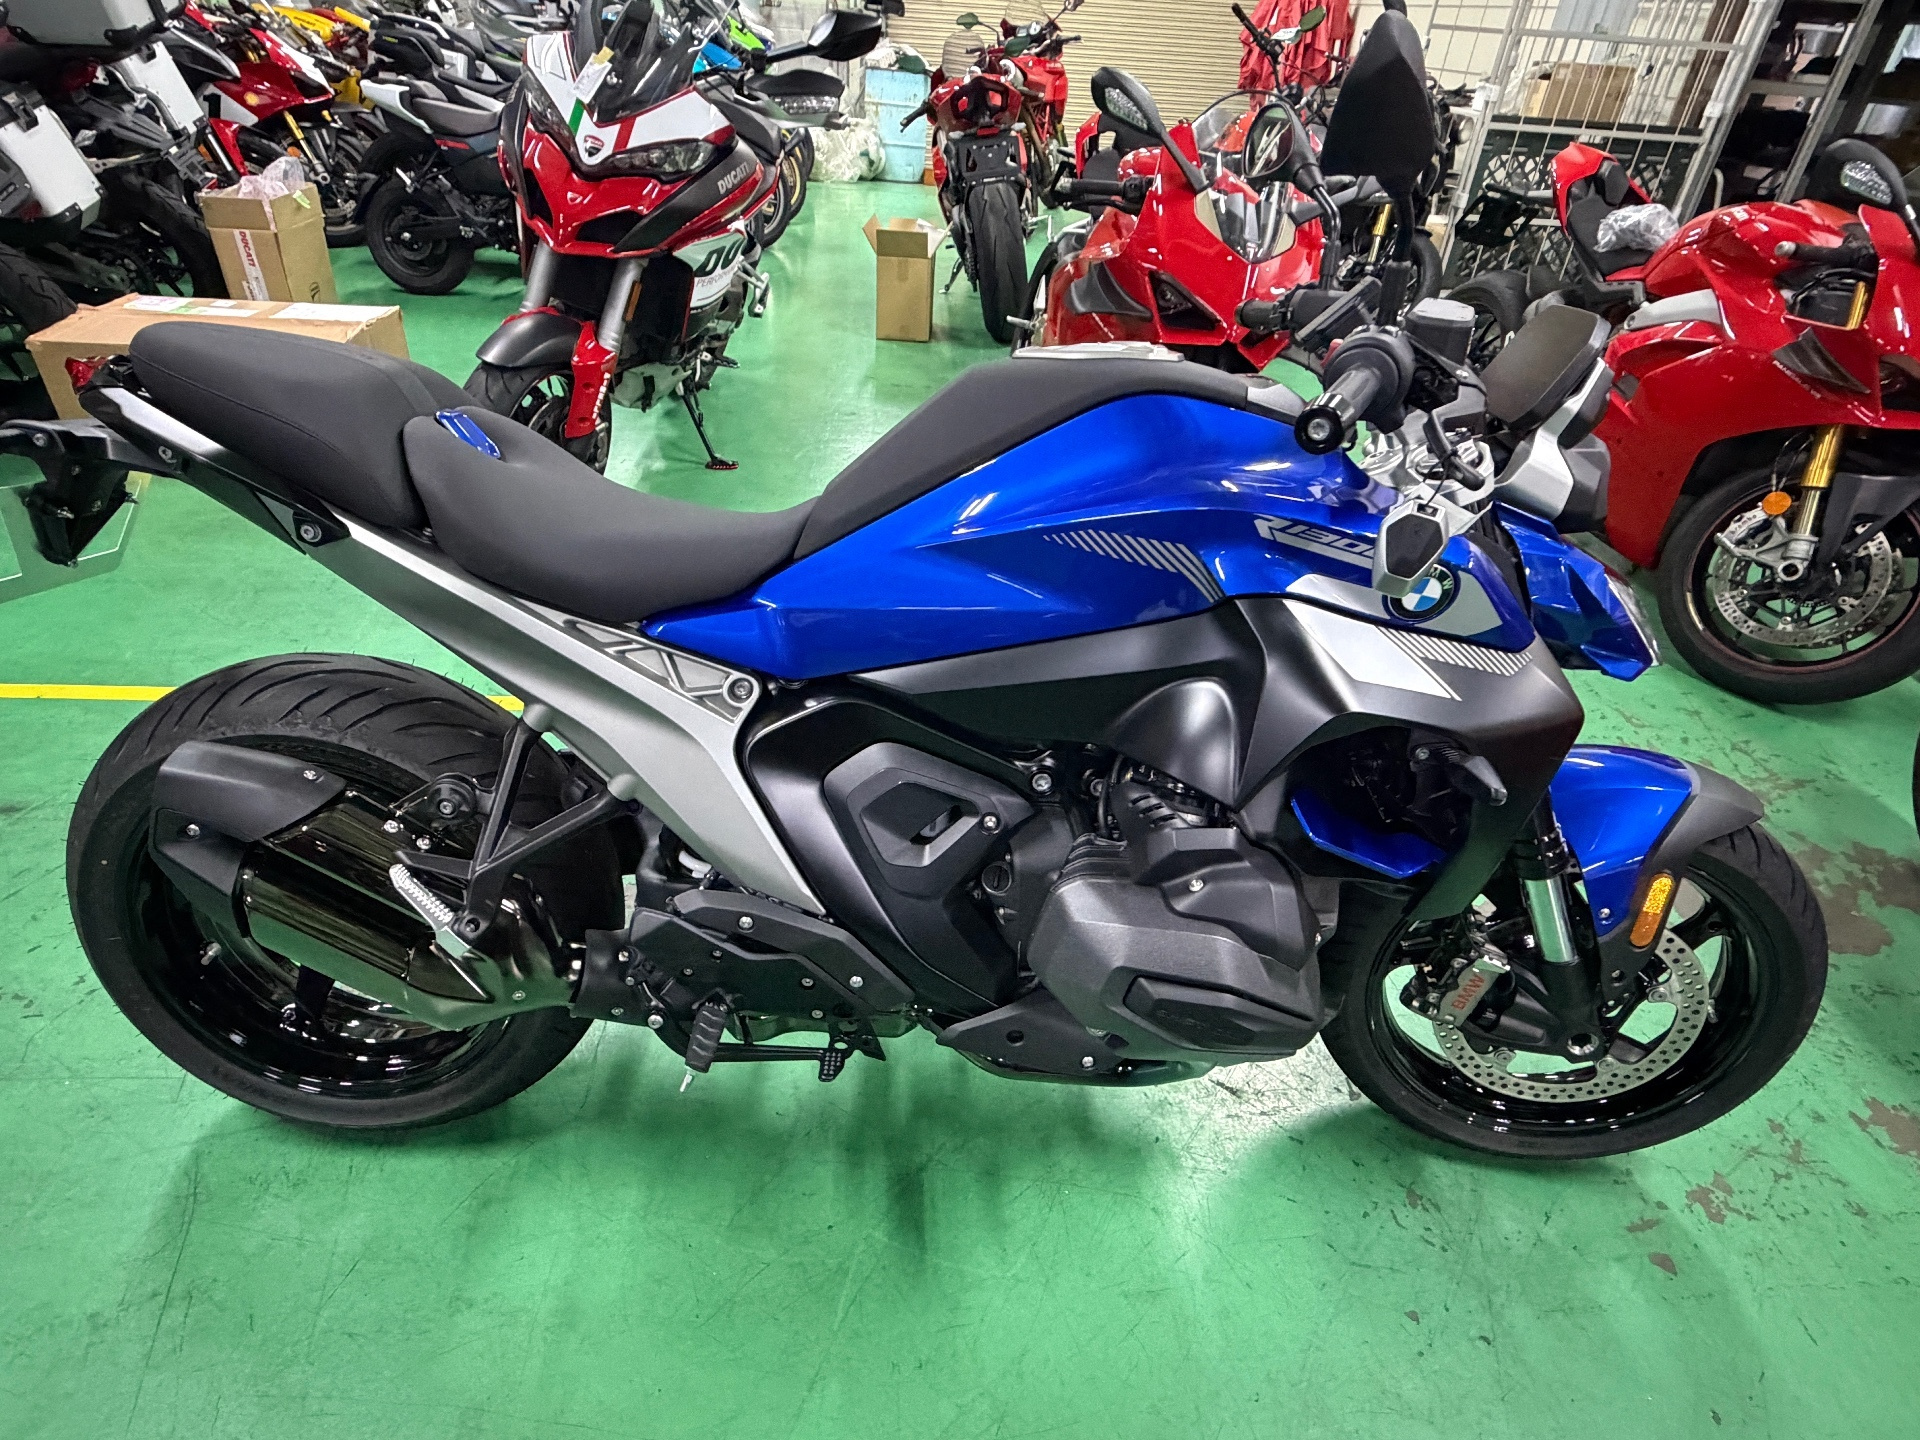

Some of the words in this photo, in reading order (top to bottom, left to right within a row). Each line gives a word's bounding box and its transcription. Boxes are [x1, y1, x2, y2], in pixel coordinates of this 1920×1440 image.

[718, 162, 749, 194] DUCATI
[239, 230, 256, 267] DUCATI
[1730, 514, 1757, 535] brembo
[1452, 973, 1485, 1010] BMW
